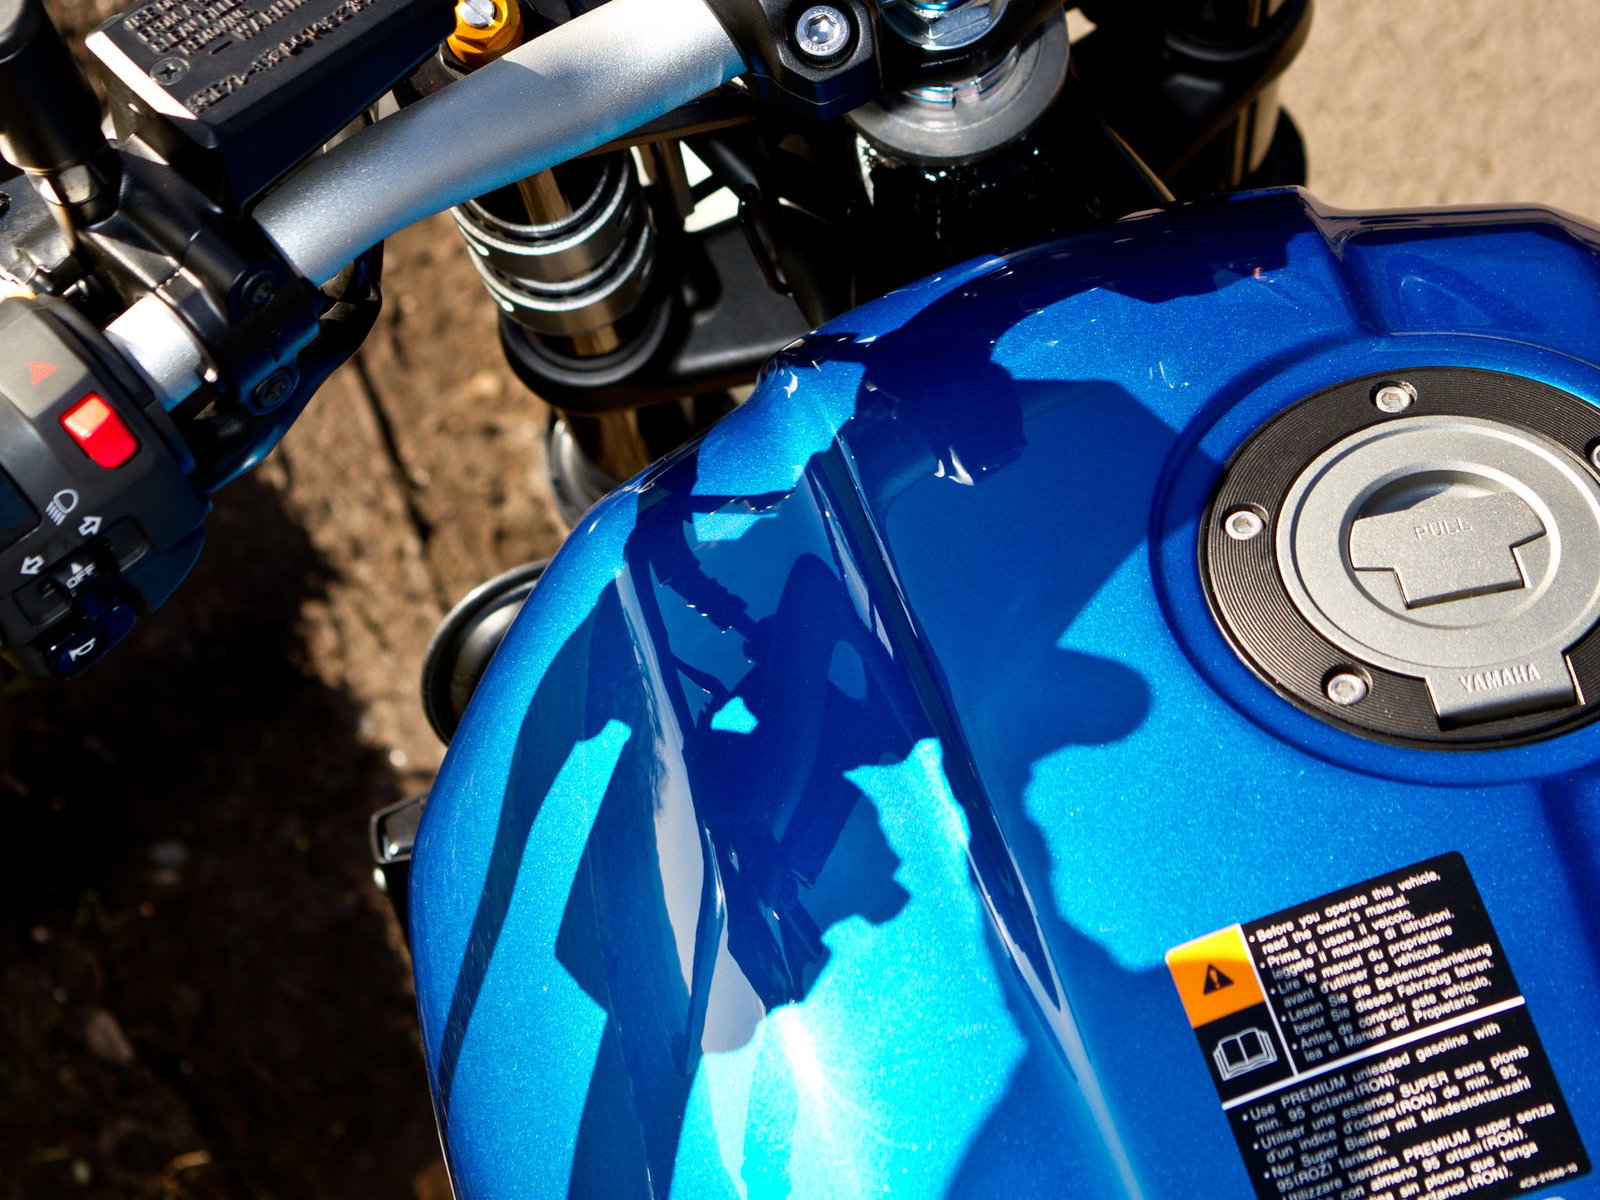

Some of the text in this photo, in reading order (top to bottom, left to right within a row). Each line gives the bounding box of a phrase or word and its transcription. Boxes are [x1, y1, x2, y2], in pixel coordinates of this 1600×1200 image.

[1414, 518, 1473, 540] PULL
[66, 562, 96, 589] OFF
[1458, 663, 1541, 694] YAMAHA
